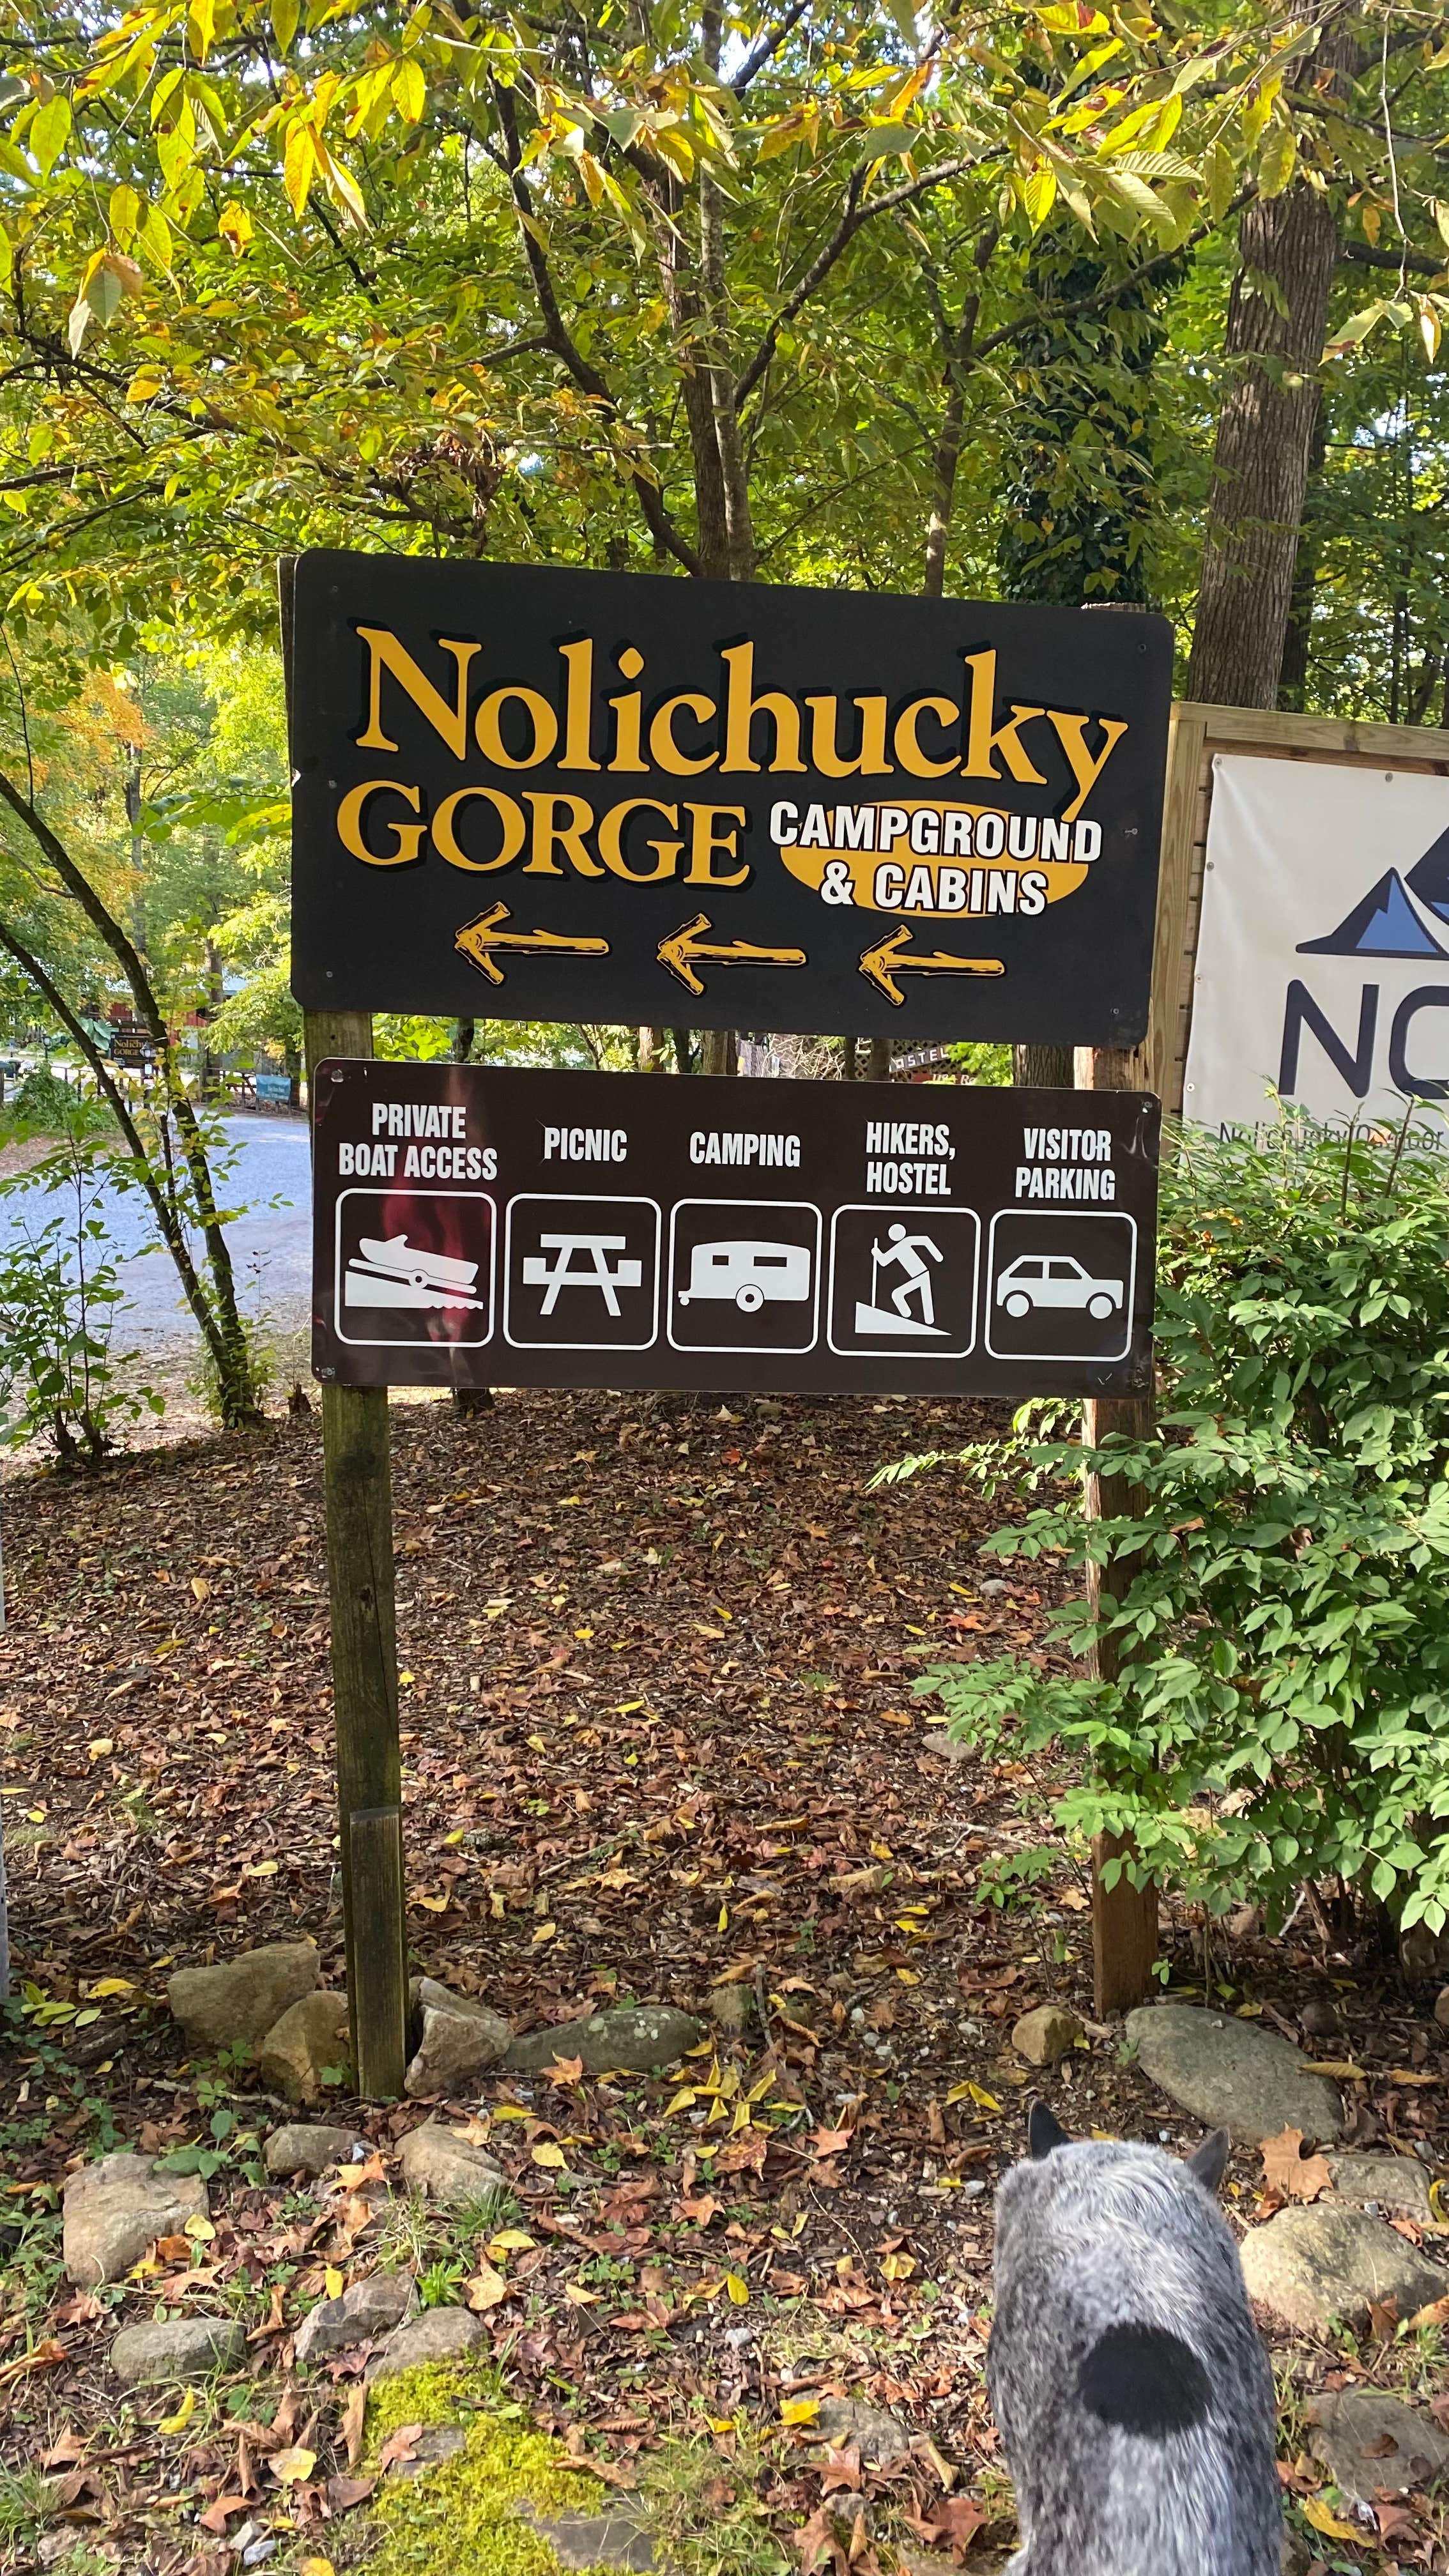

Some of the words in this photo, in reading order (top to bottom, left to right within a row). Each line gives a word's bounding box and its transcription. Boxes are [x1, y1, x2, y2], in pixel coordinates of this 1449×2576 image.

[356, 626, 1128, 822] Nolichucky
[337, 779, 751, 886] GORGE
[769, 801, 1102, 862] CAMPGROUND
[820, 861, 854, 906] &
[874, 864, 1047, 916] CABINS
[889, 1047, 950, 1072] OSTEL
[372, 1103, 467, 1139] PRIVATE
[544, 1126, 627, 1162] PICNIC
[689, 1131, 801, 1168] CAMPING
[866, 1121, 956, 1160] HIKERS,
[1023, 1128, 1112, 1162] VISITOR
[338, 1142, 399, 1177] BOAT
[404, 1146, 498, 1181] ACCESS
[866, 1162, 952, 1195] HOSTEL
[1015, 1167, 1116, 1201] PARKING
